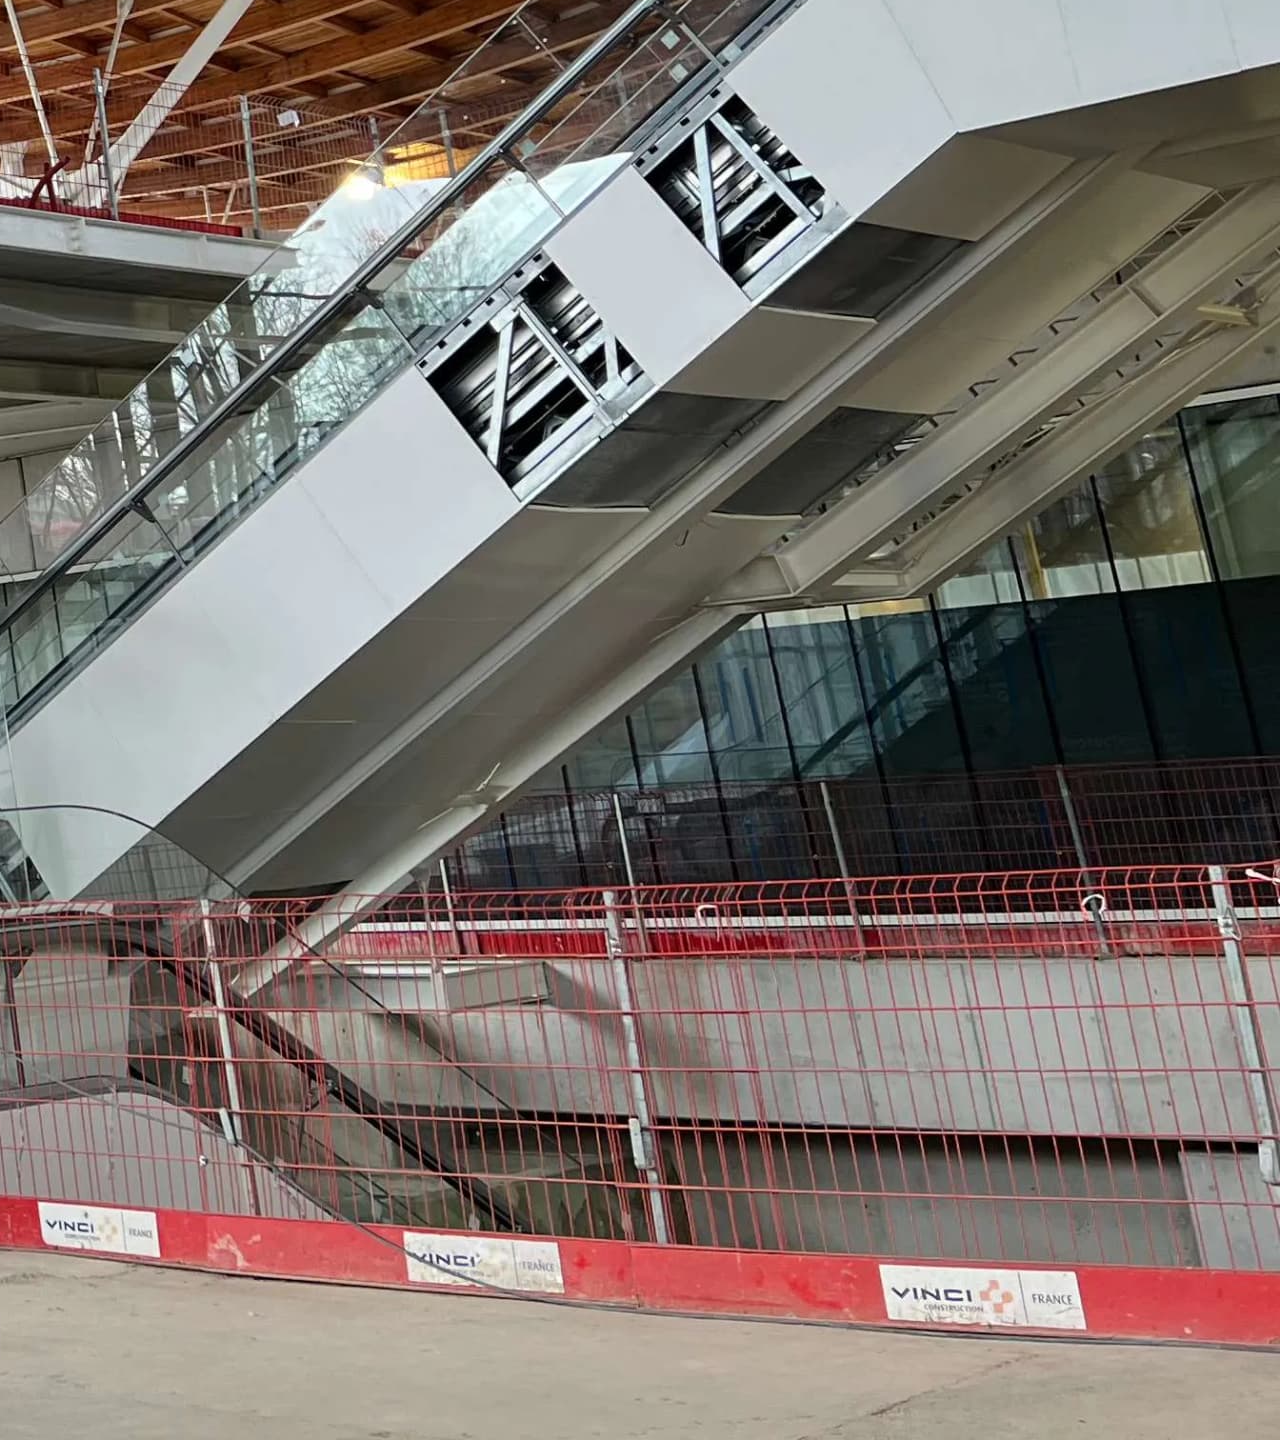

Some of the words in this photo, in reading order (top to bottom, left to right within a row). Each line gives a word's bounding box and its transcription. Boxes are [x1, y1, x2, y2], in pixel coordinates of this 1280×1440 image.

[45, 1219, 95, 1234] VINCI
[891, 1286, 973, 1303] VINCI
[1031, 1292, 1073, 1306] FRANCE
